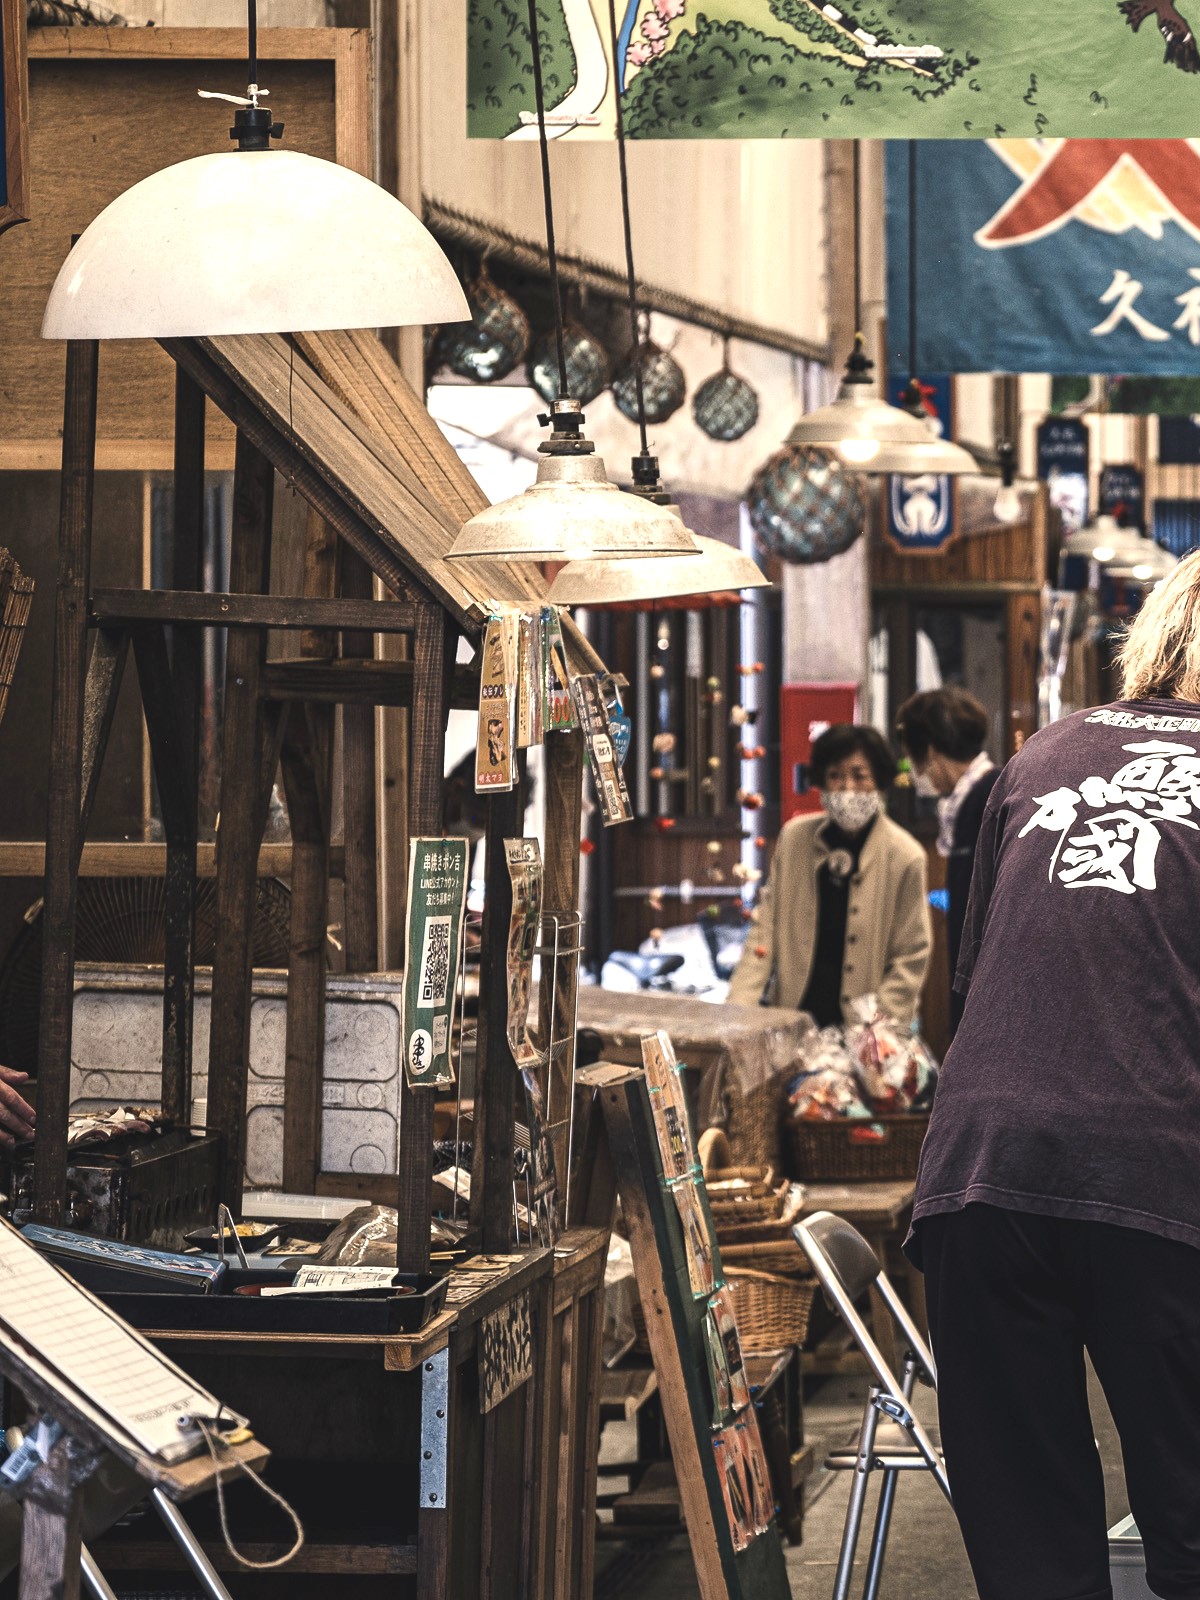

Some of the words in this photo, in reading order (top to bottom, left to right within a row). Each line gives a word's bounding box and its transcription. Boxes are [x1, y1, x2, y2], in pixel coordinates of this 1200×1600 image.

[423, 852, 461, 872] 串焼きポン吉
